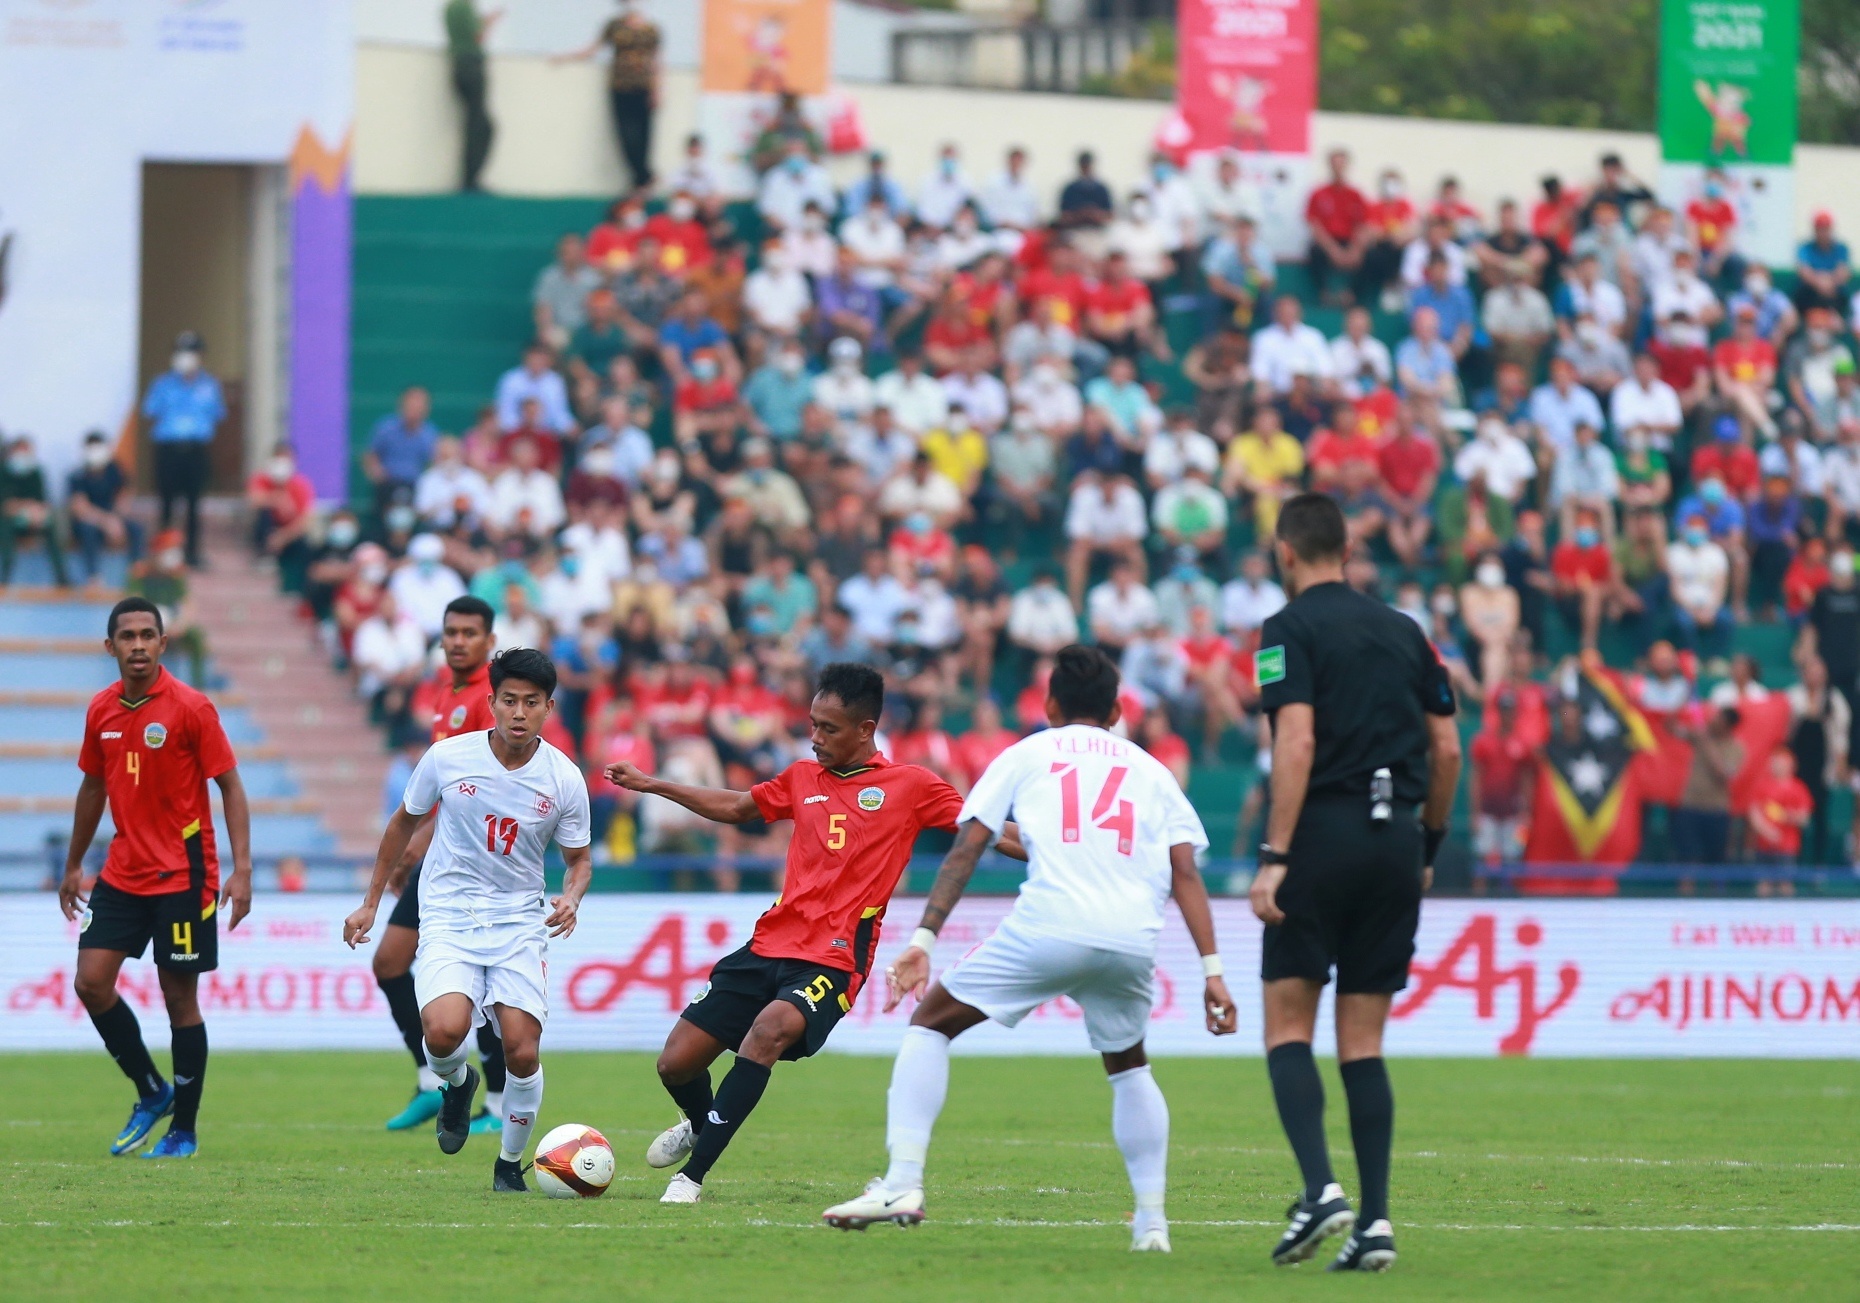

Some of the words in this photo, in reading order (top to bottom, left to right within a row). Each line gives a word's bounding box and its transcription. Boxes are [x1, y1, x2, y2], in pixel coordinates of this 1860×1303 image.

[127, 751, 140, 786] 4
[1050, 762, 1133, 856] 14
[484, 814, 519, 856] 19
[827, 814, 847, 850] 5
[173, 921, 192, 955] 4
[804, 974, 834, 1003] 5
